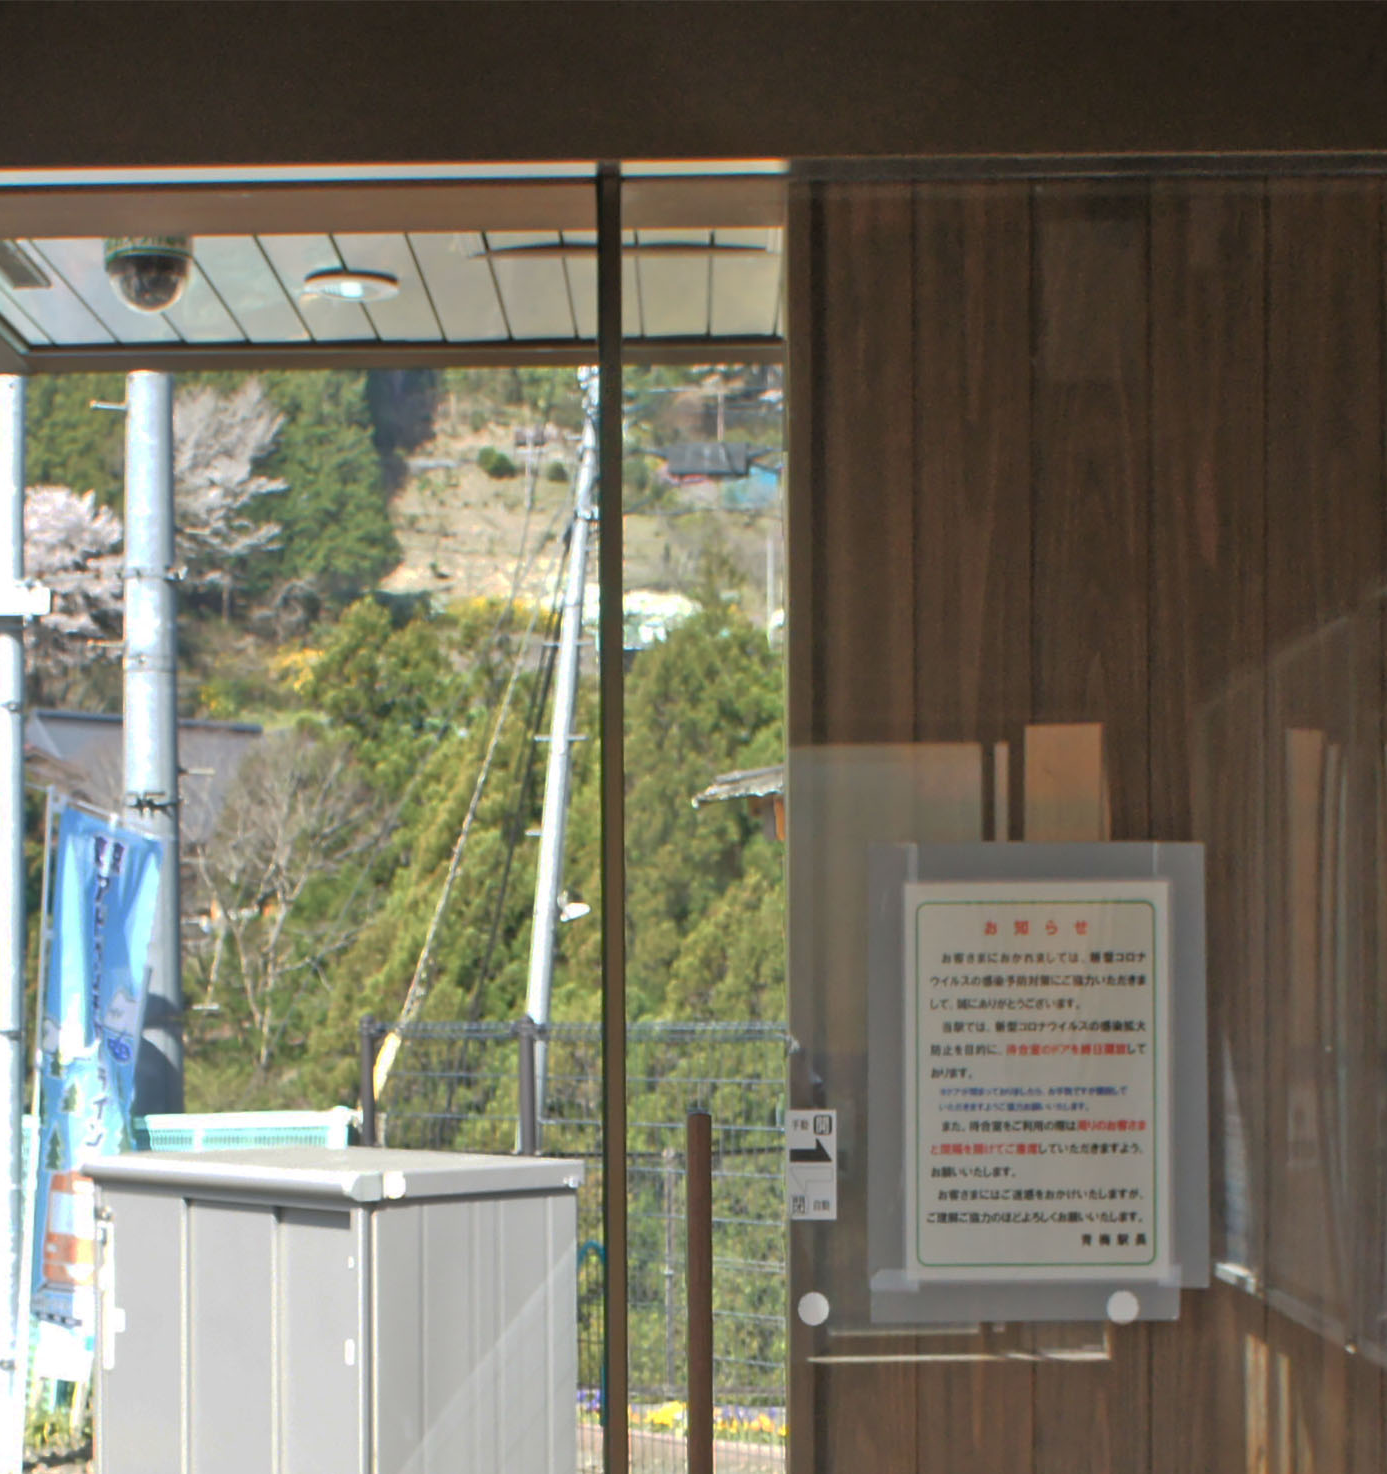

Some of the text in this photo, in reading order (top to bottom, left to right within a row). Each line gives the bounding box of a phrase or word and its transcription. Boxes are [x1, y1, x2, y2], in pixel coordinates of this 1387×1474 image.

[983, 919, 1089, 936] お知らせ
[930, 1067, 974, 1080] おります。
[930, 1166, 1018, 1179] お願いいたします。
